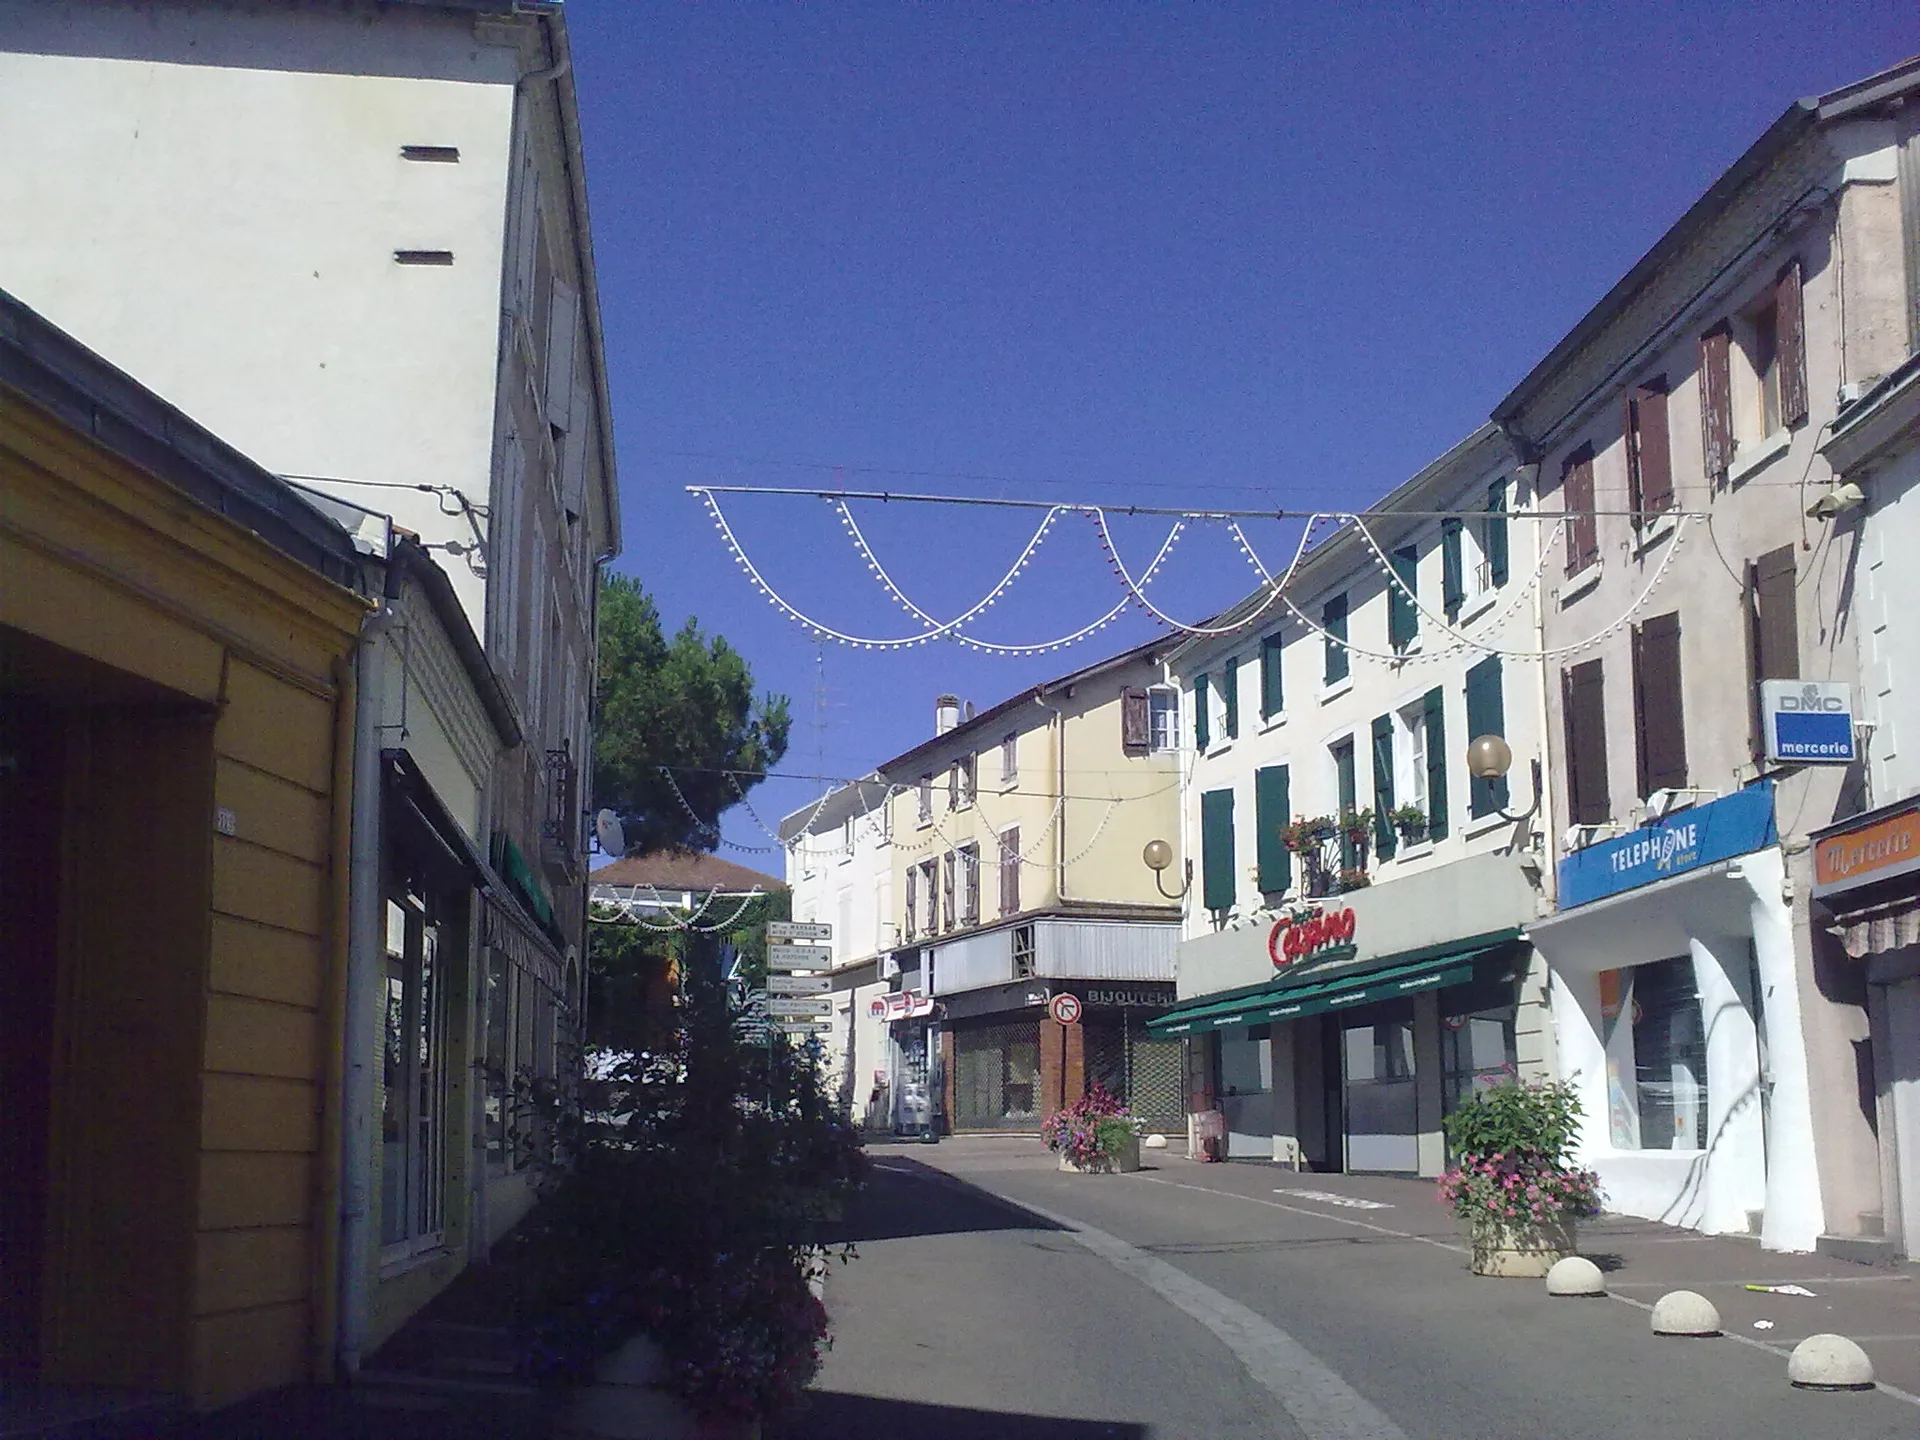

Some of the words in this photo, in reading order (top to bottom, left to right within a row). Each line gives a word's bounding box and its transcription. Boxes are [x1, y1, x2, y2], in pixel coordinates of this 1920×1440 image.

[1779, 696, 1843, 712] DMC
[1781, 741, 1849, 755] mercerie
[1610, 824, 1697, 873] TELEPHONE
[1825, 831, 1912, 875] Mercerie
